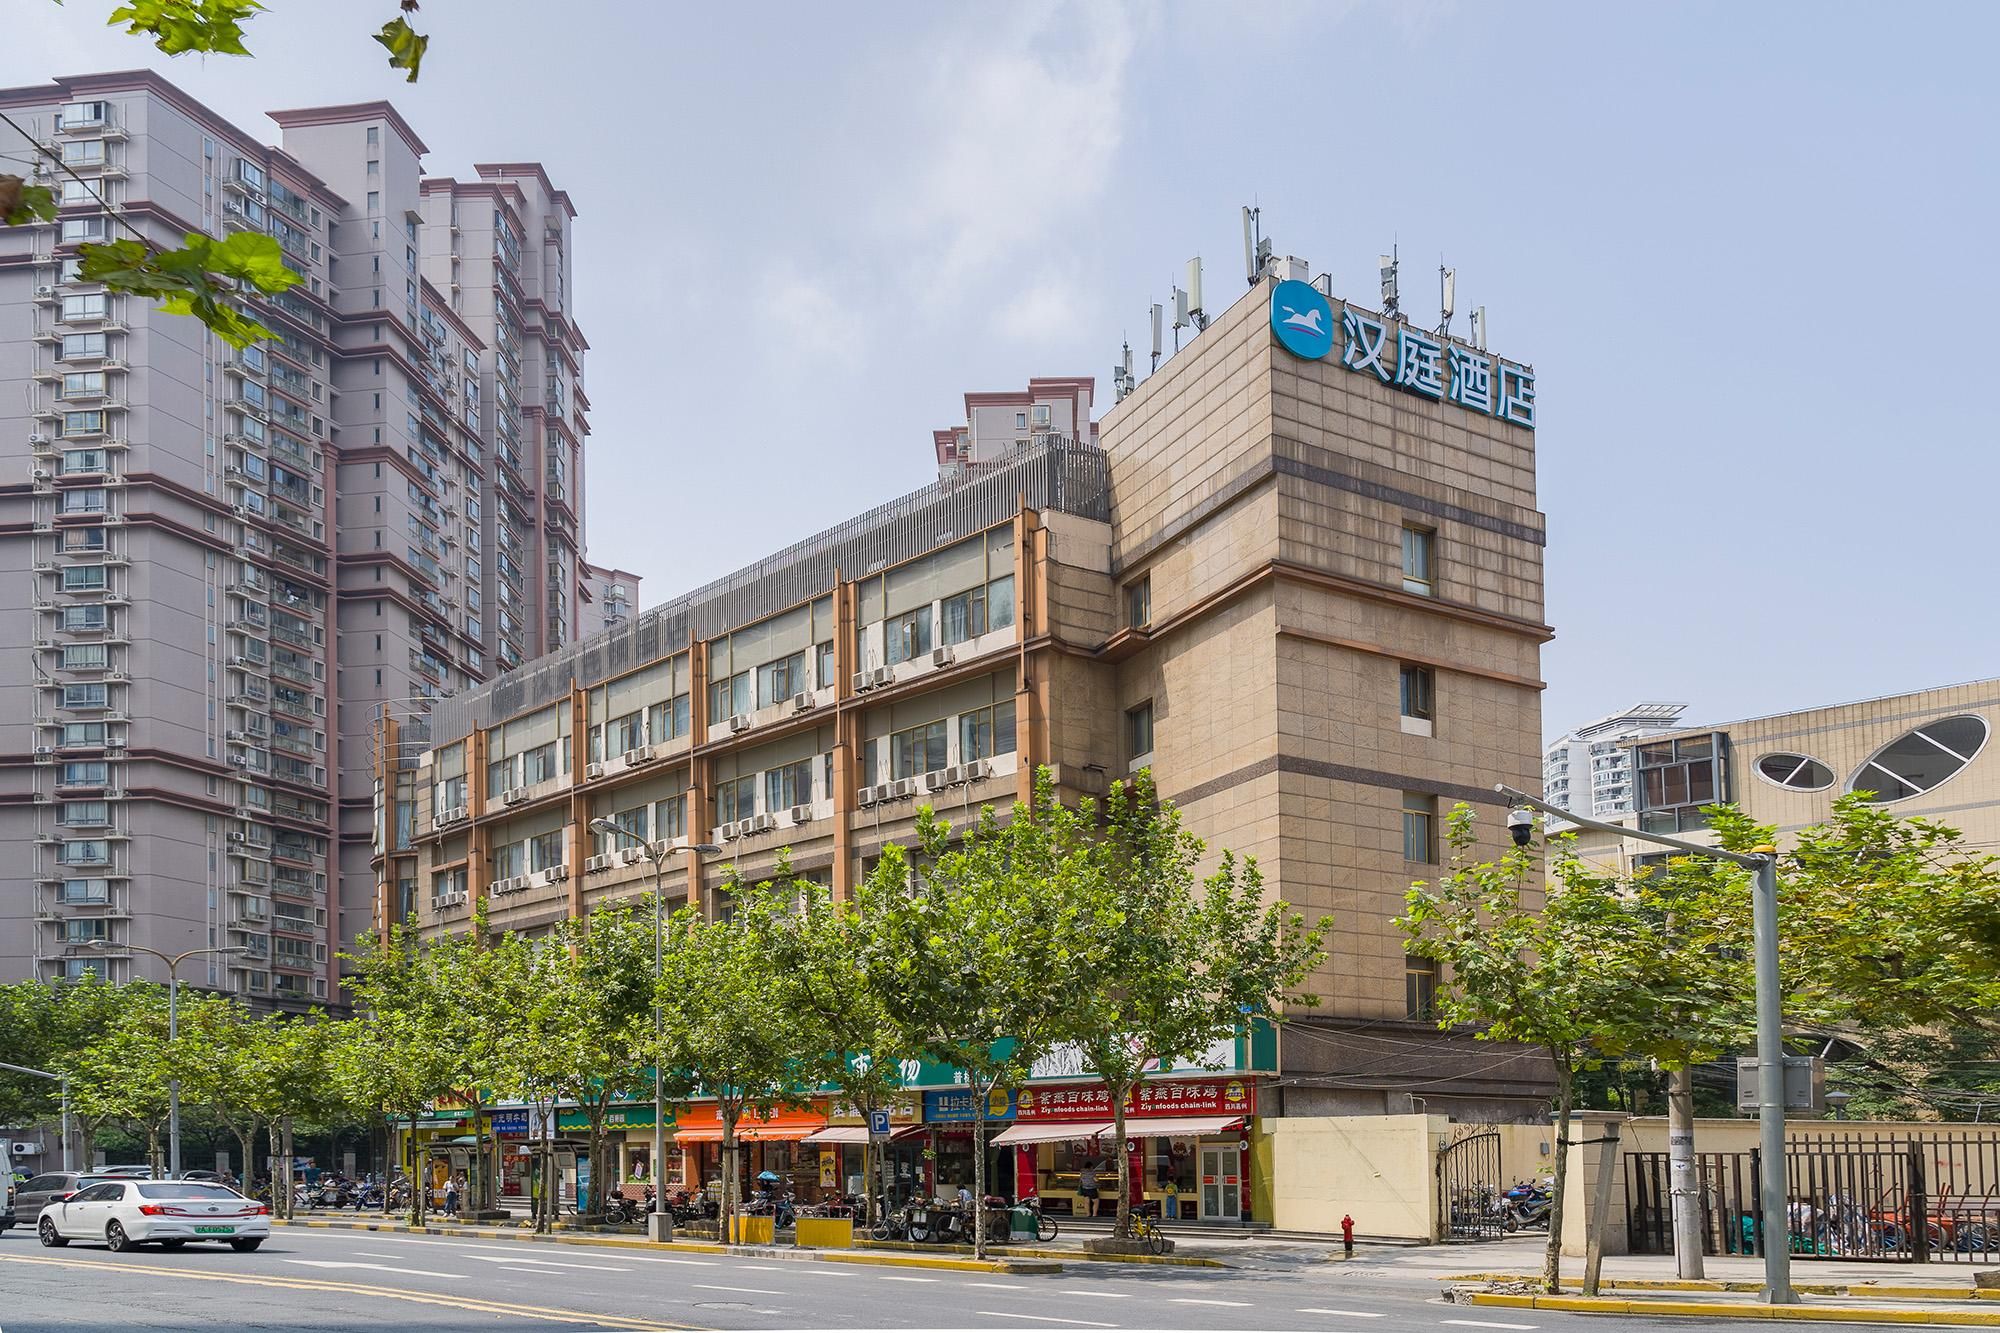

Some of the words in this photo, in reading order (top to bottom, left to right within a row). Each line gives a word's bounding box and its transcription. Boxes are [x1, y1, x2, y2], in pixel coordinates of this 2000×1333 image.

[1342, 306, 1536, 429] 汉庭酒店
[1040, 1090, 1110, 1104] 紫燕百味鸡
[1139, 1084, 1218, 1101] 紫燕百味鸡
[874, 1114, 885, 1130] P
